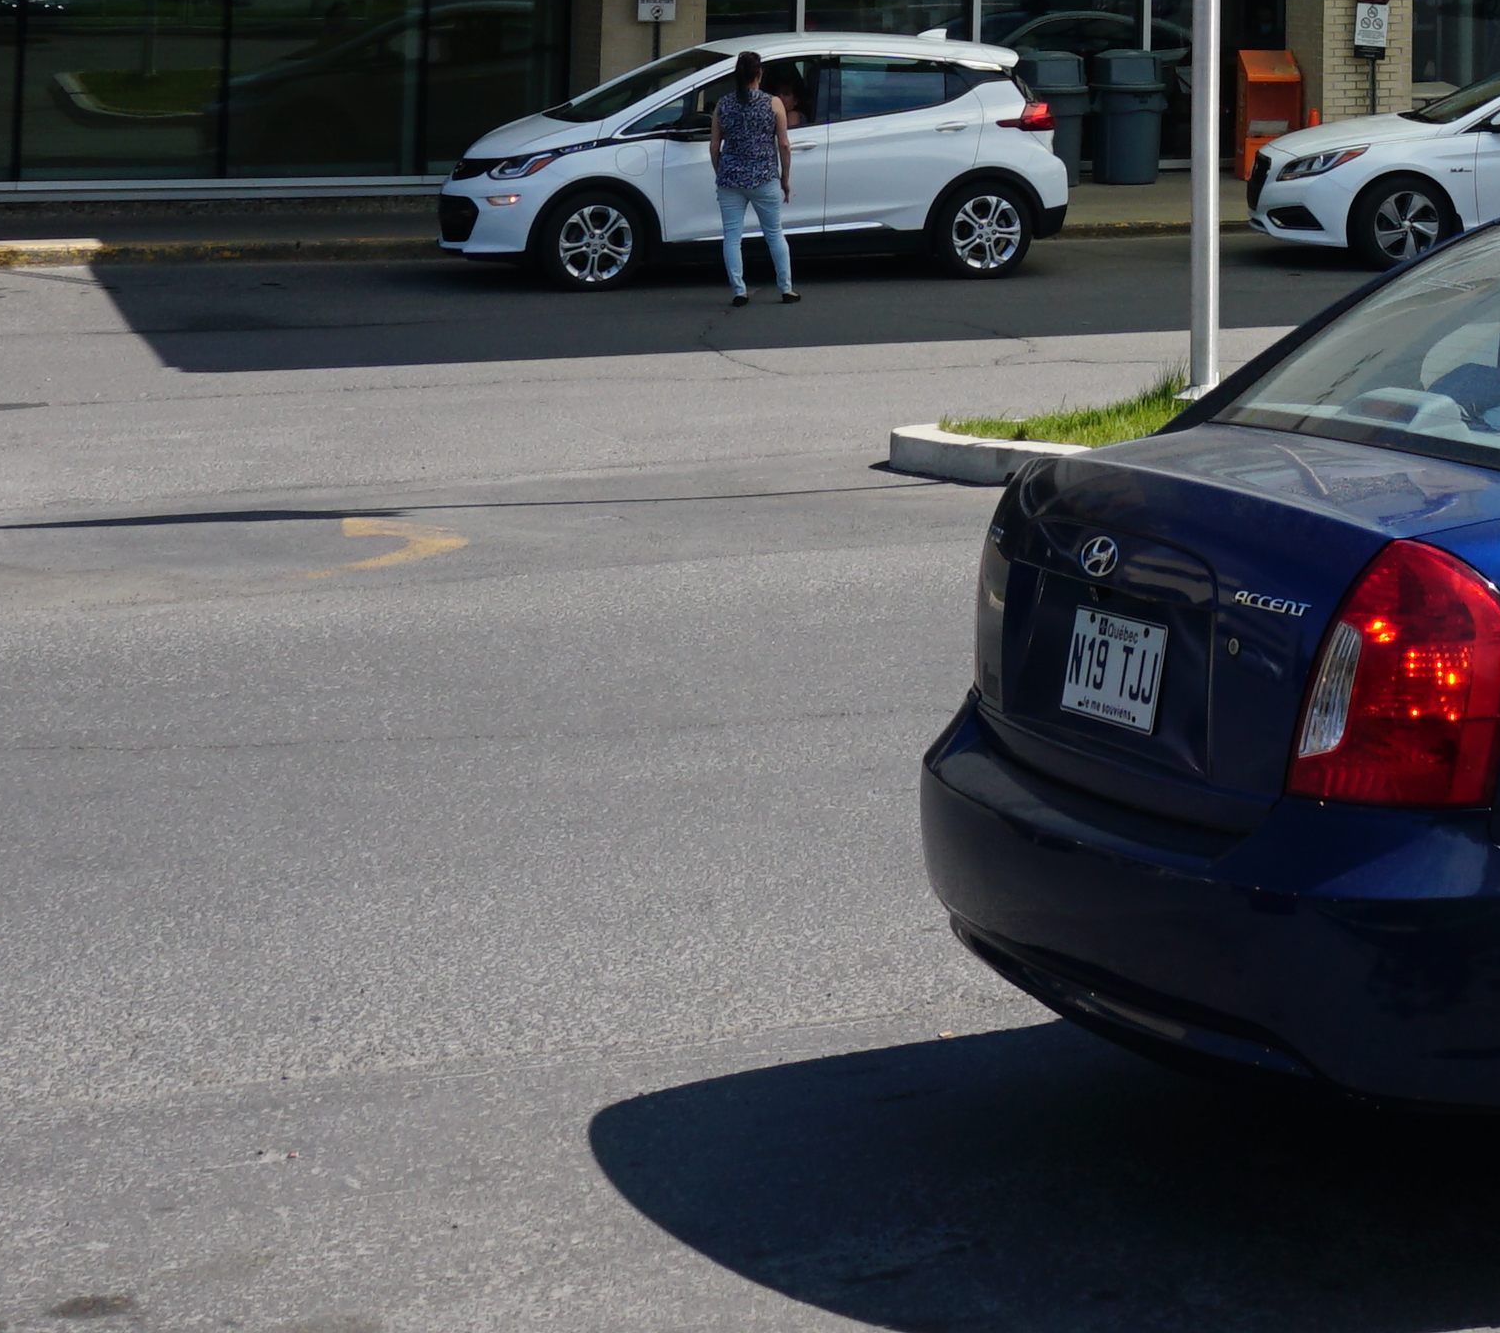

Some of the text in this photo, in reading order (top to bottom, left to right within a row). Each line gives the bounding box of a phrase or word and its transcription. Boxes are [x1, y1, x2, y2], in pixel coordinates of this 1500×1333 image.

[1233, 590, 1313, 617] ACCENT
[1107, 623, 1139, 645] Québec
[1068, 632, 1159, 705] N19 TJJ
[1090, 700, 1101, 712] me
[1101, 703, 1132, 721] souviens
